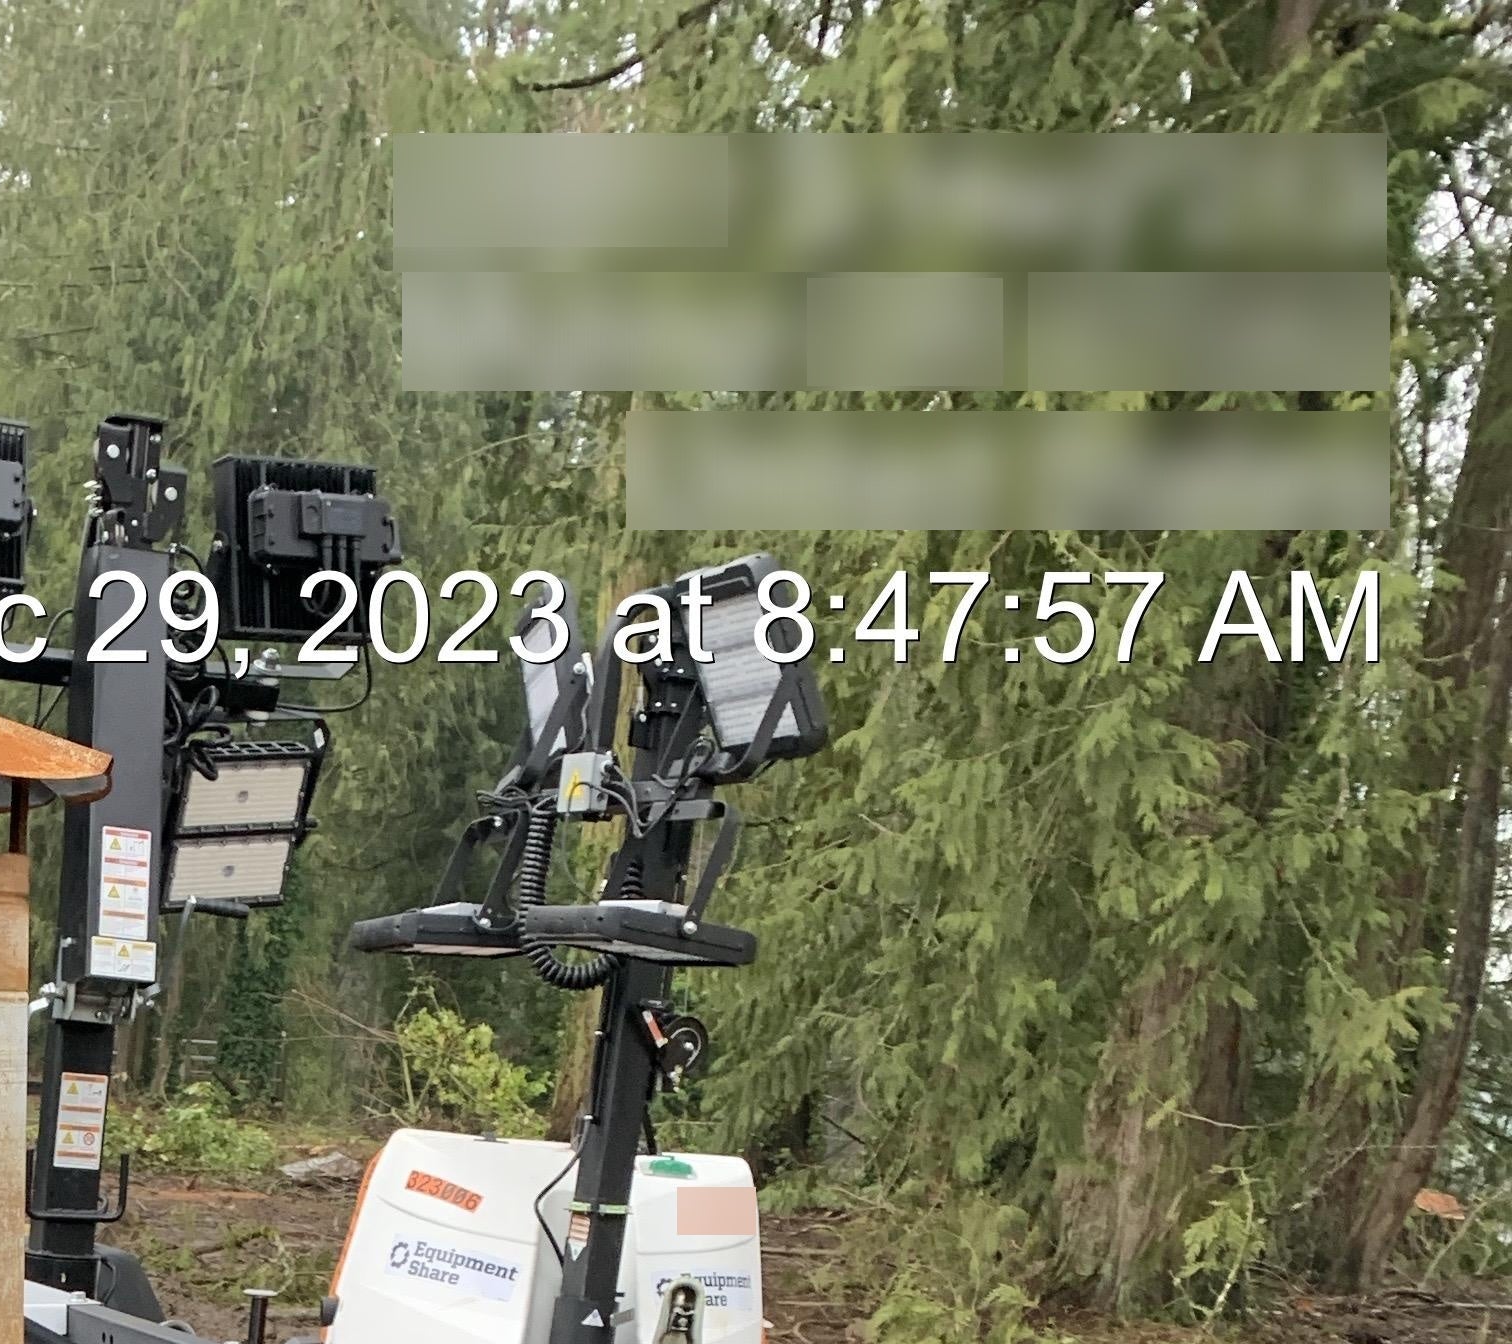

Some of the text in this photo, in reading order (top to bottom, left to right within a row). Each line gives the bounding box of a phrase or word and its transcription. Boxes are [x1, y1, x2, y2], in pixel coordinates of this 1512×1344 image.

[406, 1170, 483, 1212] 323006
[407, 1260, 461, 1286] Share
[413, 1241, 520, 1282] Equipment
